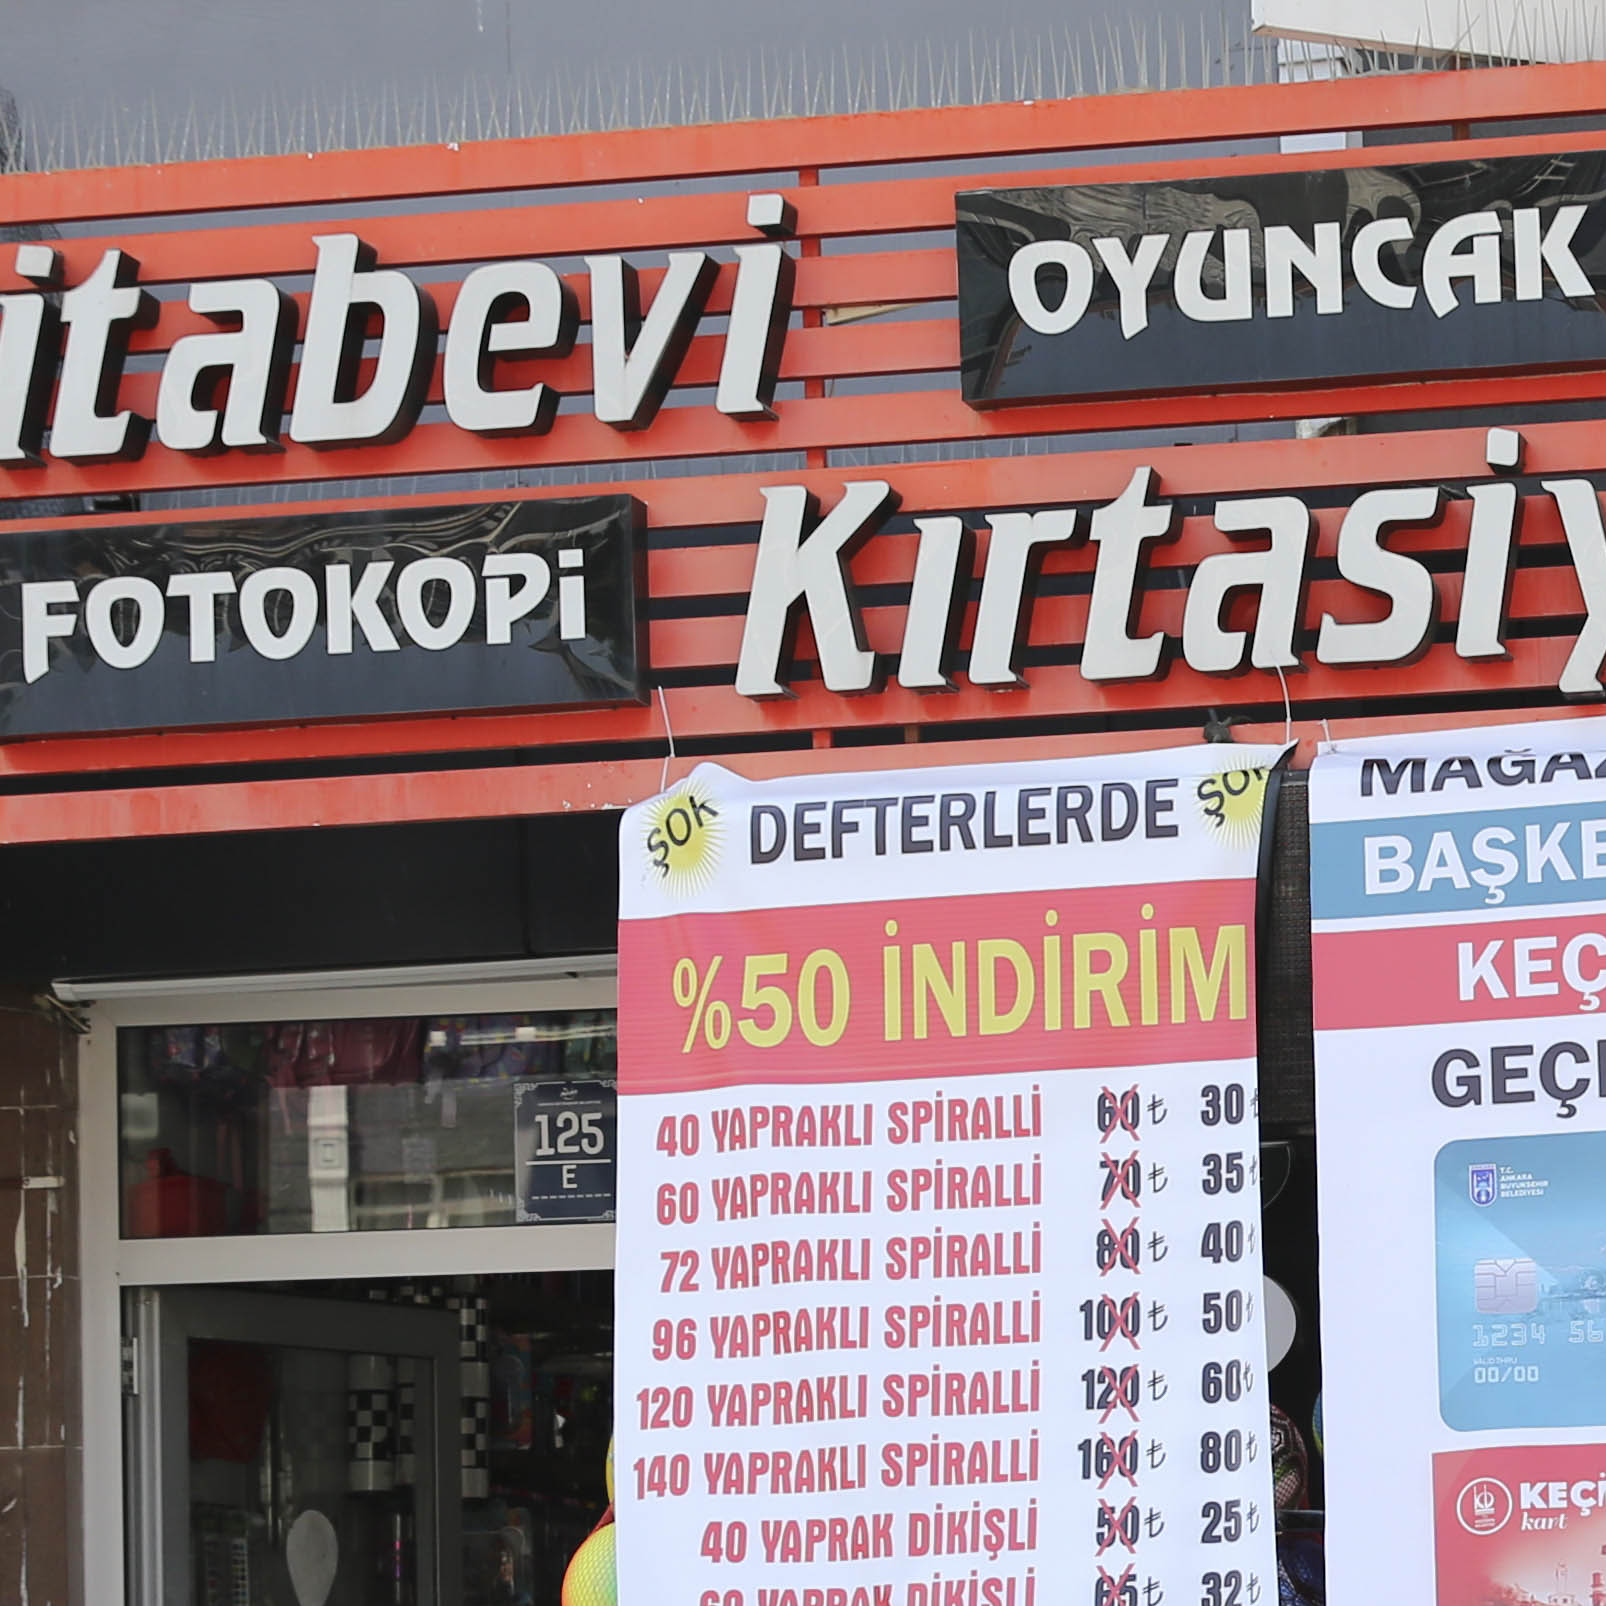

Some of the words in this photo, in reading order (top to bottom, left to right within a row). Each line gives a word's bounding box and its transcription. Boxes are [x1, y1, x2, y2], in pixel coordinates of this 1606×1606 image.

[1007, 205, 1595, 341] OYUNCAK
[646, 790, 719, 877] ŞOK
[750, 778, 1180, 865] DEFTERLERDE
[672, 948, 852, 1054] %50
[883, 903, 1248, 1042] İNDİRİM
[535, 1111, 604, 1156] 125
[656, 1114, 698, 1156] 40
[712, 1103, 872, 1155] YAPRAKLI
[888, 1084, 1041, 1145] SPİRALLİ
[562, 1165, 578, 1189] E
[657, 1181, 698, 1225] 60
[712, 1171, 871, 1221] YAPRAKLI
[887, 1153, 1041, 1211] SPİRALLİ
[659, 1250, 698, 1293] 72
[711, 1239, 870, 1290] YAPRAKLI
[885, 1221, 1041, 1281] SPİRALLİ
[652, 1318, 697, 1361] 96
[710, 1306, 868, 1359] YAPRAKLI
[884, 1290, 1041, 1348] SPİRALLİ
[1472, 1323, 1546, 1348] 1234
[637, 1386, 692, 1430] 120
[708, 1374, 867, 1427] YAPRAKLI
[882, 1360, 1040, 1416] SPİRALLİ
[1474, 1366, 1539, 1384] 00/00
[633, 1454, 689, 1499] 140
[704, 1445, 866, 1496] YAPRAKLI
[881, 1429, 1038, 1487] SPİRALLİ
[701, 1520, 747, 1563] 40
[762, 1513, 894, 1563] YAPRAK
[908, 1497, 1038, 1560] DİKİŞLİ
[1521, 1511, 1568, 1531] kart
